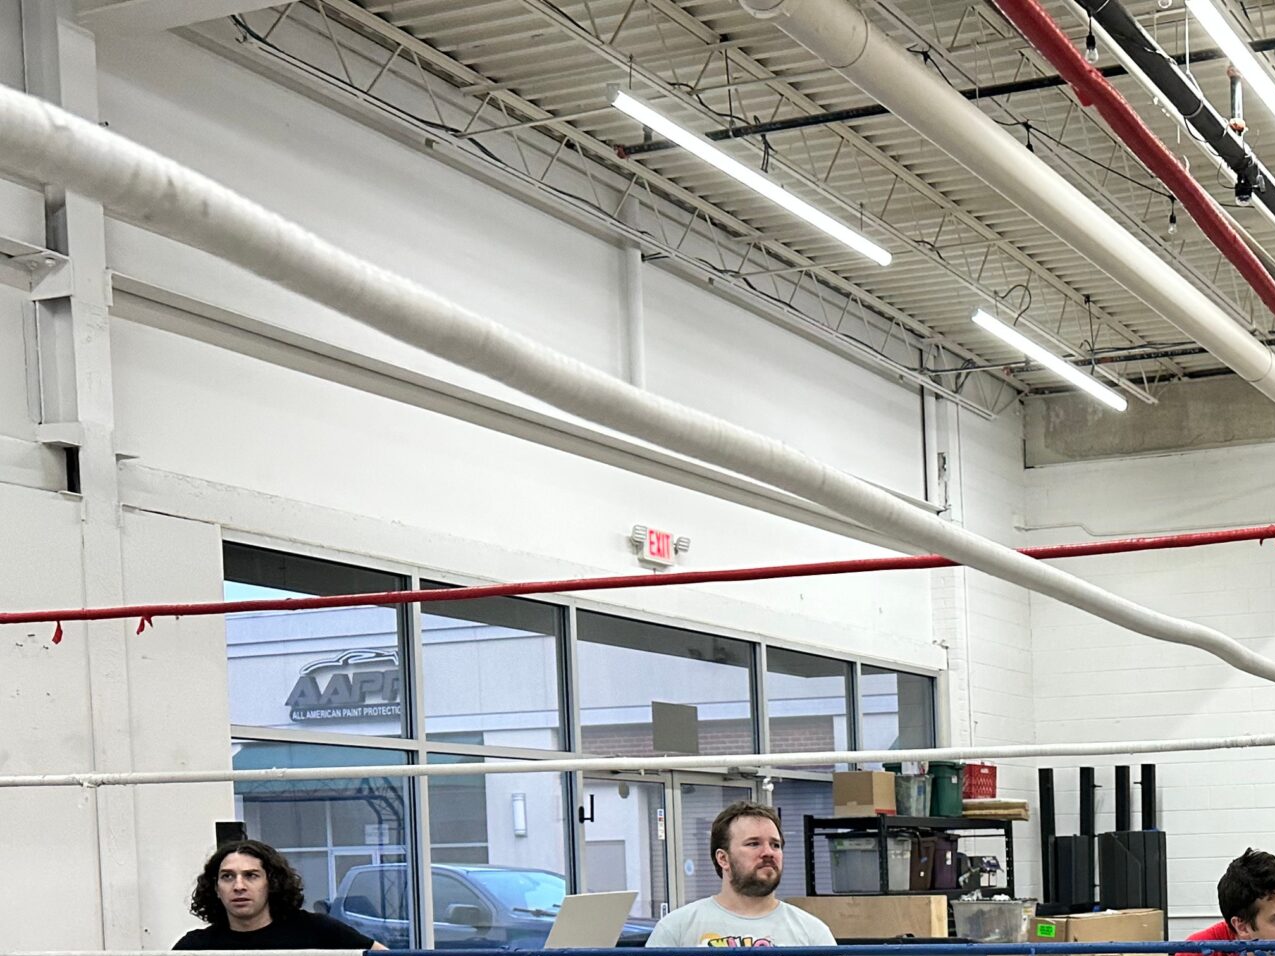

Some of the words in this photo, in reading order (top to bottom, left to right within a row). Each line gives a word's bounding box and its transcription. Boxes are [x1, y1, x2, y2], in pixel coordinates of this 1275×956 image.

[649, 529, 672, 559] EXIT
[293, 711, 305, 720] ALL
[306, 709, 341, 718] AMERICAN
[342, 707, 362, 717] PAINT
